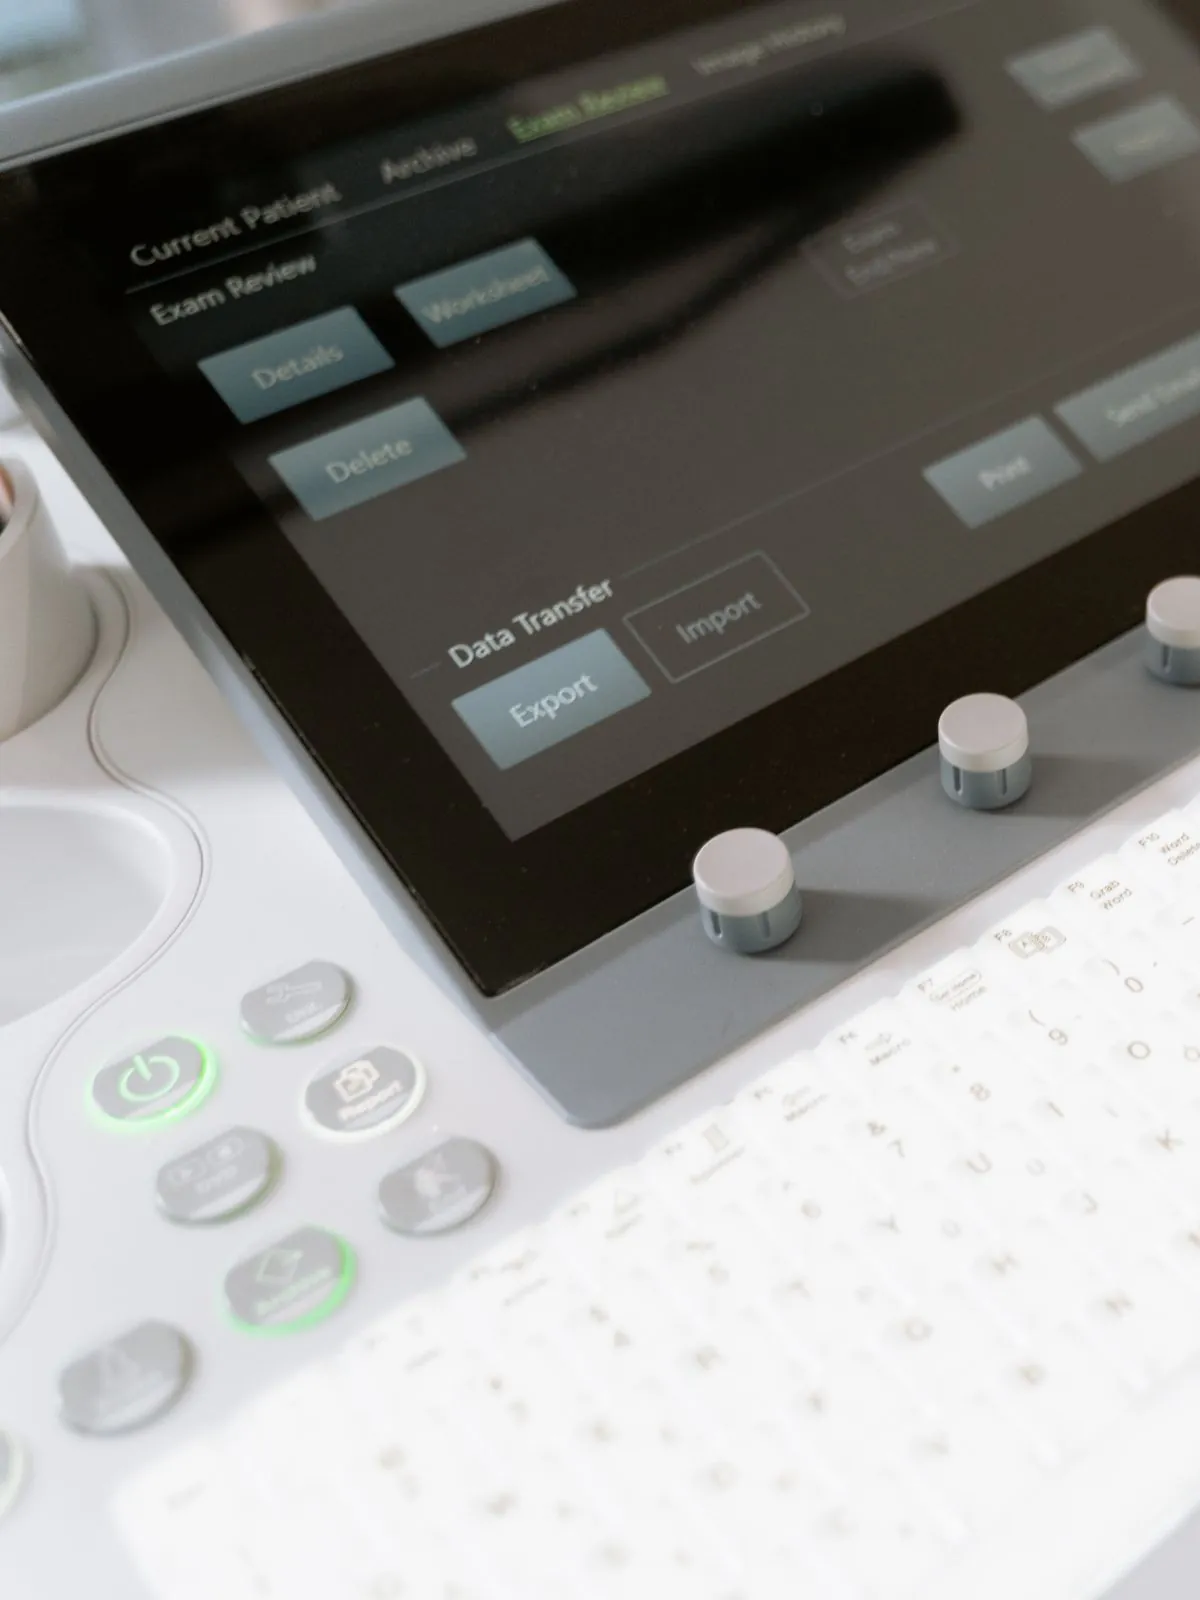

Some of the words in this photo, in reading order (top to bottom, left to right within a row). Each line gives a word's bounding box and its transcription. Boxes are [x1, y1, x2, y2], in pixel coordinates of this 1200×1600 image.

[379, 136, 478, 185] Archive
[130, 216, 242, 267] Current
[240, 181, 343, 230] Patient
[150, 287, 227, 326] Exam
[224, 253, 317, 299] Review
[421, 264, 550, 323] Worksheet
[251, 344, 345, 391] Details
[325, 438, 413, 484] Delete
[447, 626, 516, 669] Data
[511, 577, 614, 636] Transfer
[675, 591, 764, 645] Import
[508, 672, 600, 729] Export
[1160, 832, 1190, 855] Word
[1103, 887, 1133, 910] Word
[1048, 1027, 1070, 1046] 9
[1154, 1126, 1186, 1153] K
